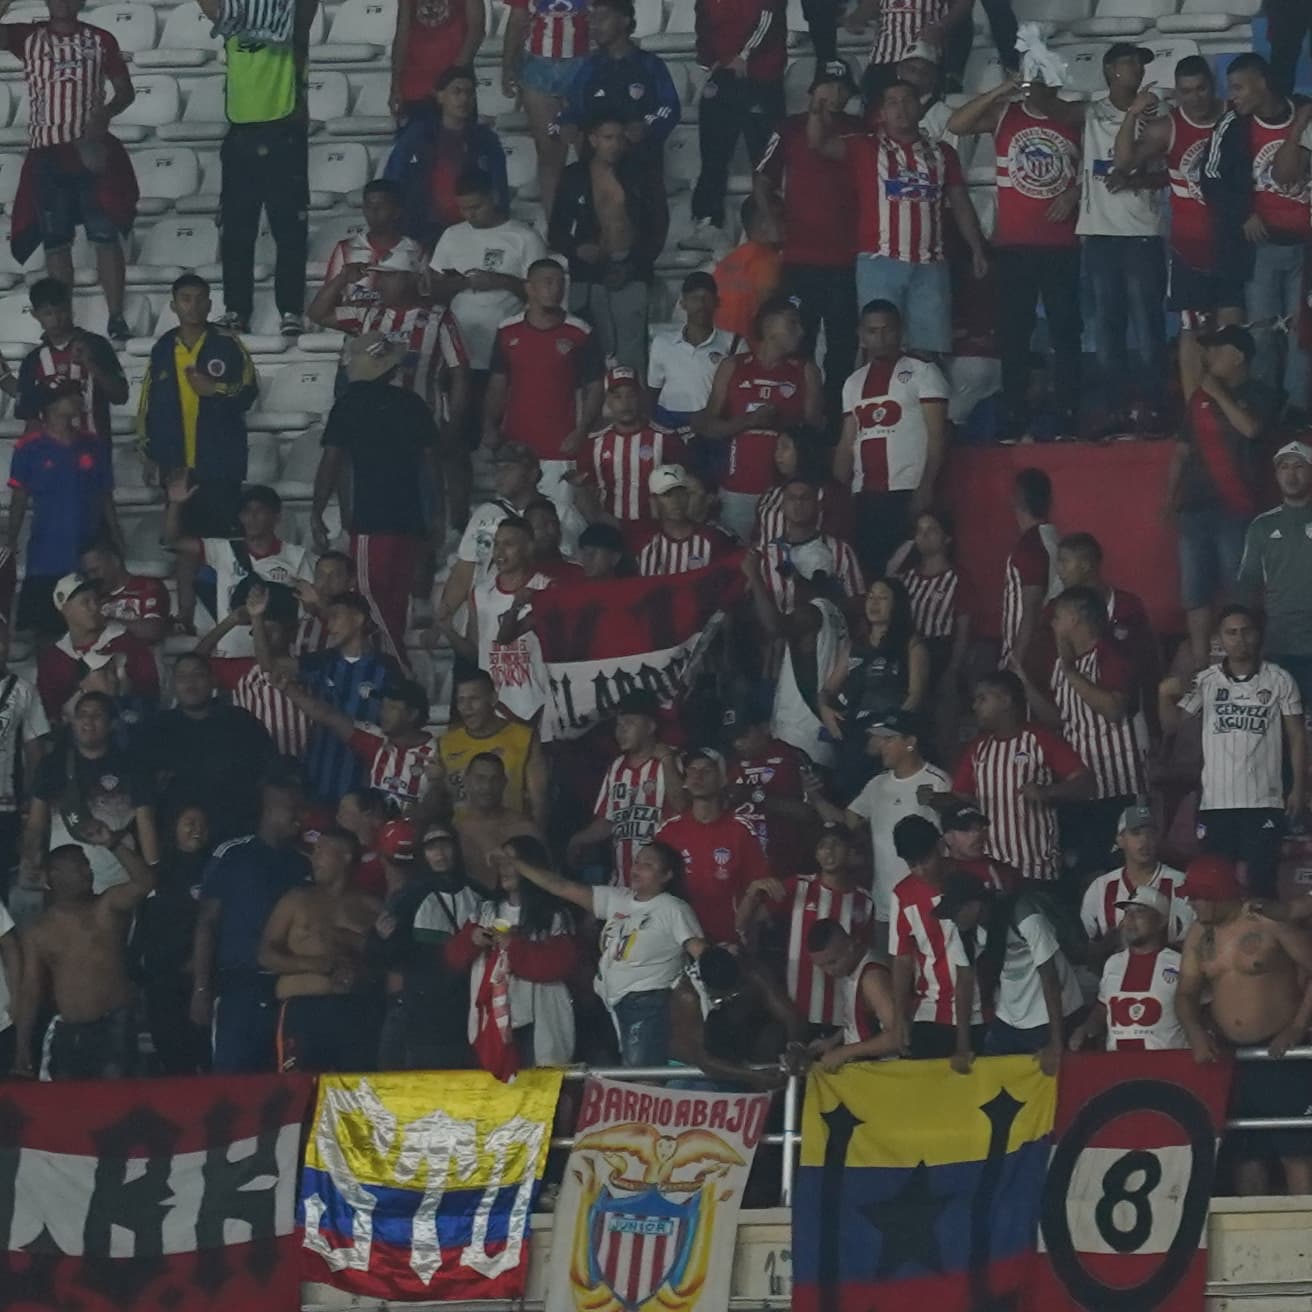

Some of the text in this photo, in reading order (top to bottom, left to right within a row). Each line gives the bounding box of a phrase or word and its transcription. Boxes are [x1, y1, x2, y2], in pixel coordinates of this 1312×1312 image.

[1215, 703, 1268, 718] CERVEZA
[1214, 716, 1268, 731] AGUILA
[1108, 995, 1163, 1028] 100
[577, 1080, 772, 1148] BARRIO ABAJO
[1095, 1149, 1163, 1255] 8
[612, 1218, 668, 1235] JUNIOR
